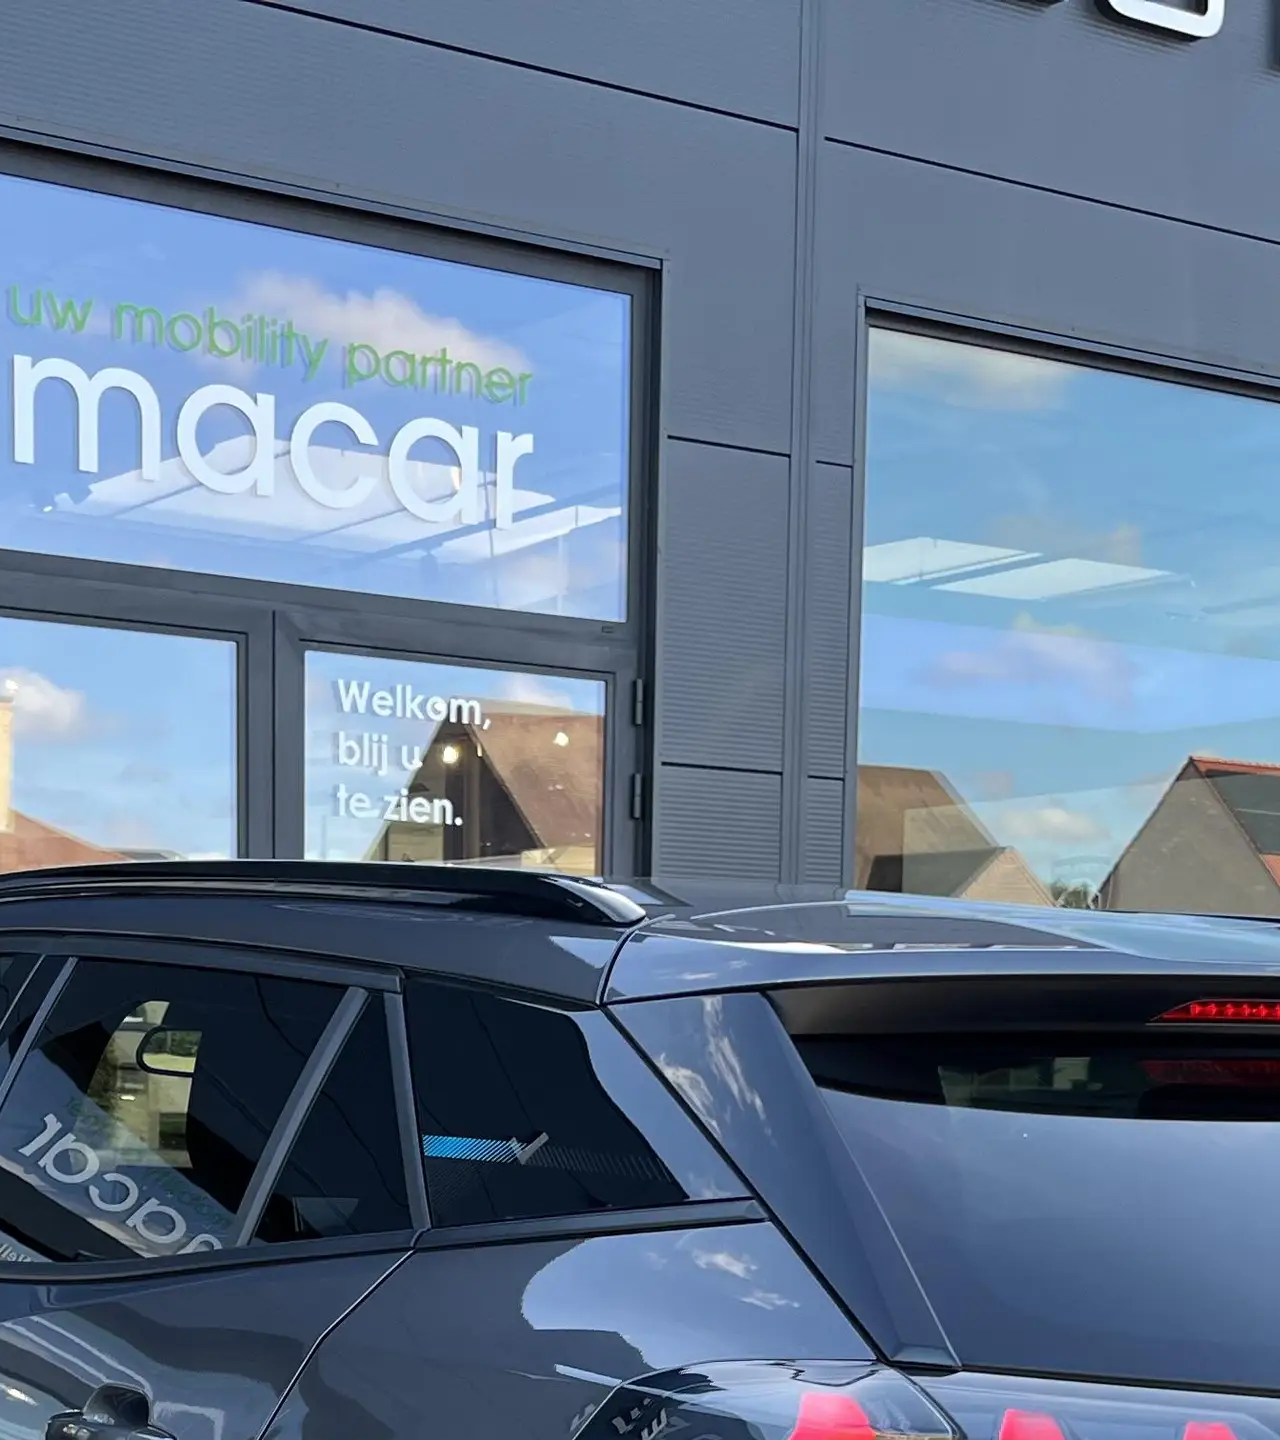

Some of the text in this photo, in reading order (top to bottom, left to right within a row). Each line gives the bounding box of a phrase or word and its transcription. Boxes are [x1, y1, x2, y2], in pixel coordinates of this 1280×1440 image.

[8, 283, 534, 407] uw mobility partner
[336, 678, 492, 731] Welkom,
[336, 731, 424, 776] blij u
[336, 783, 464, 827] te zien.
